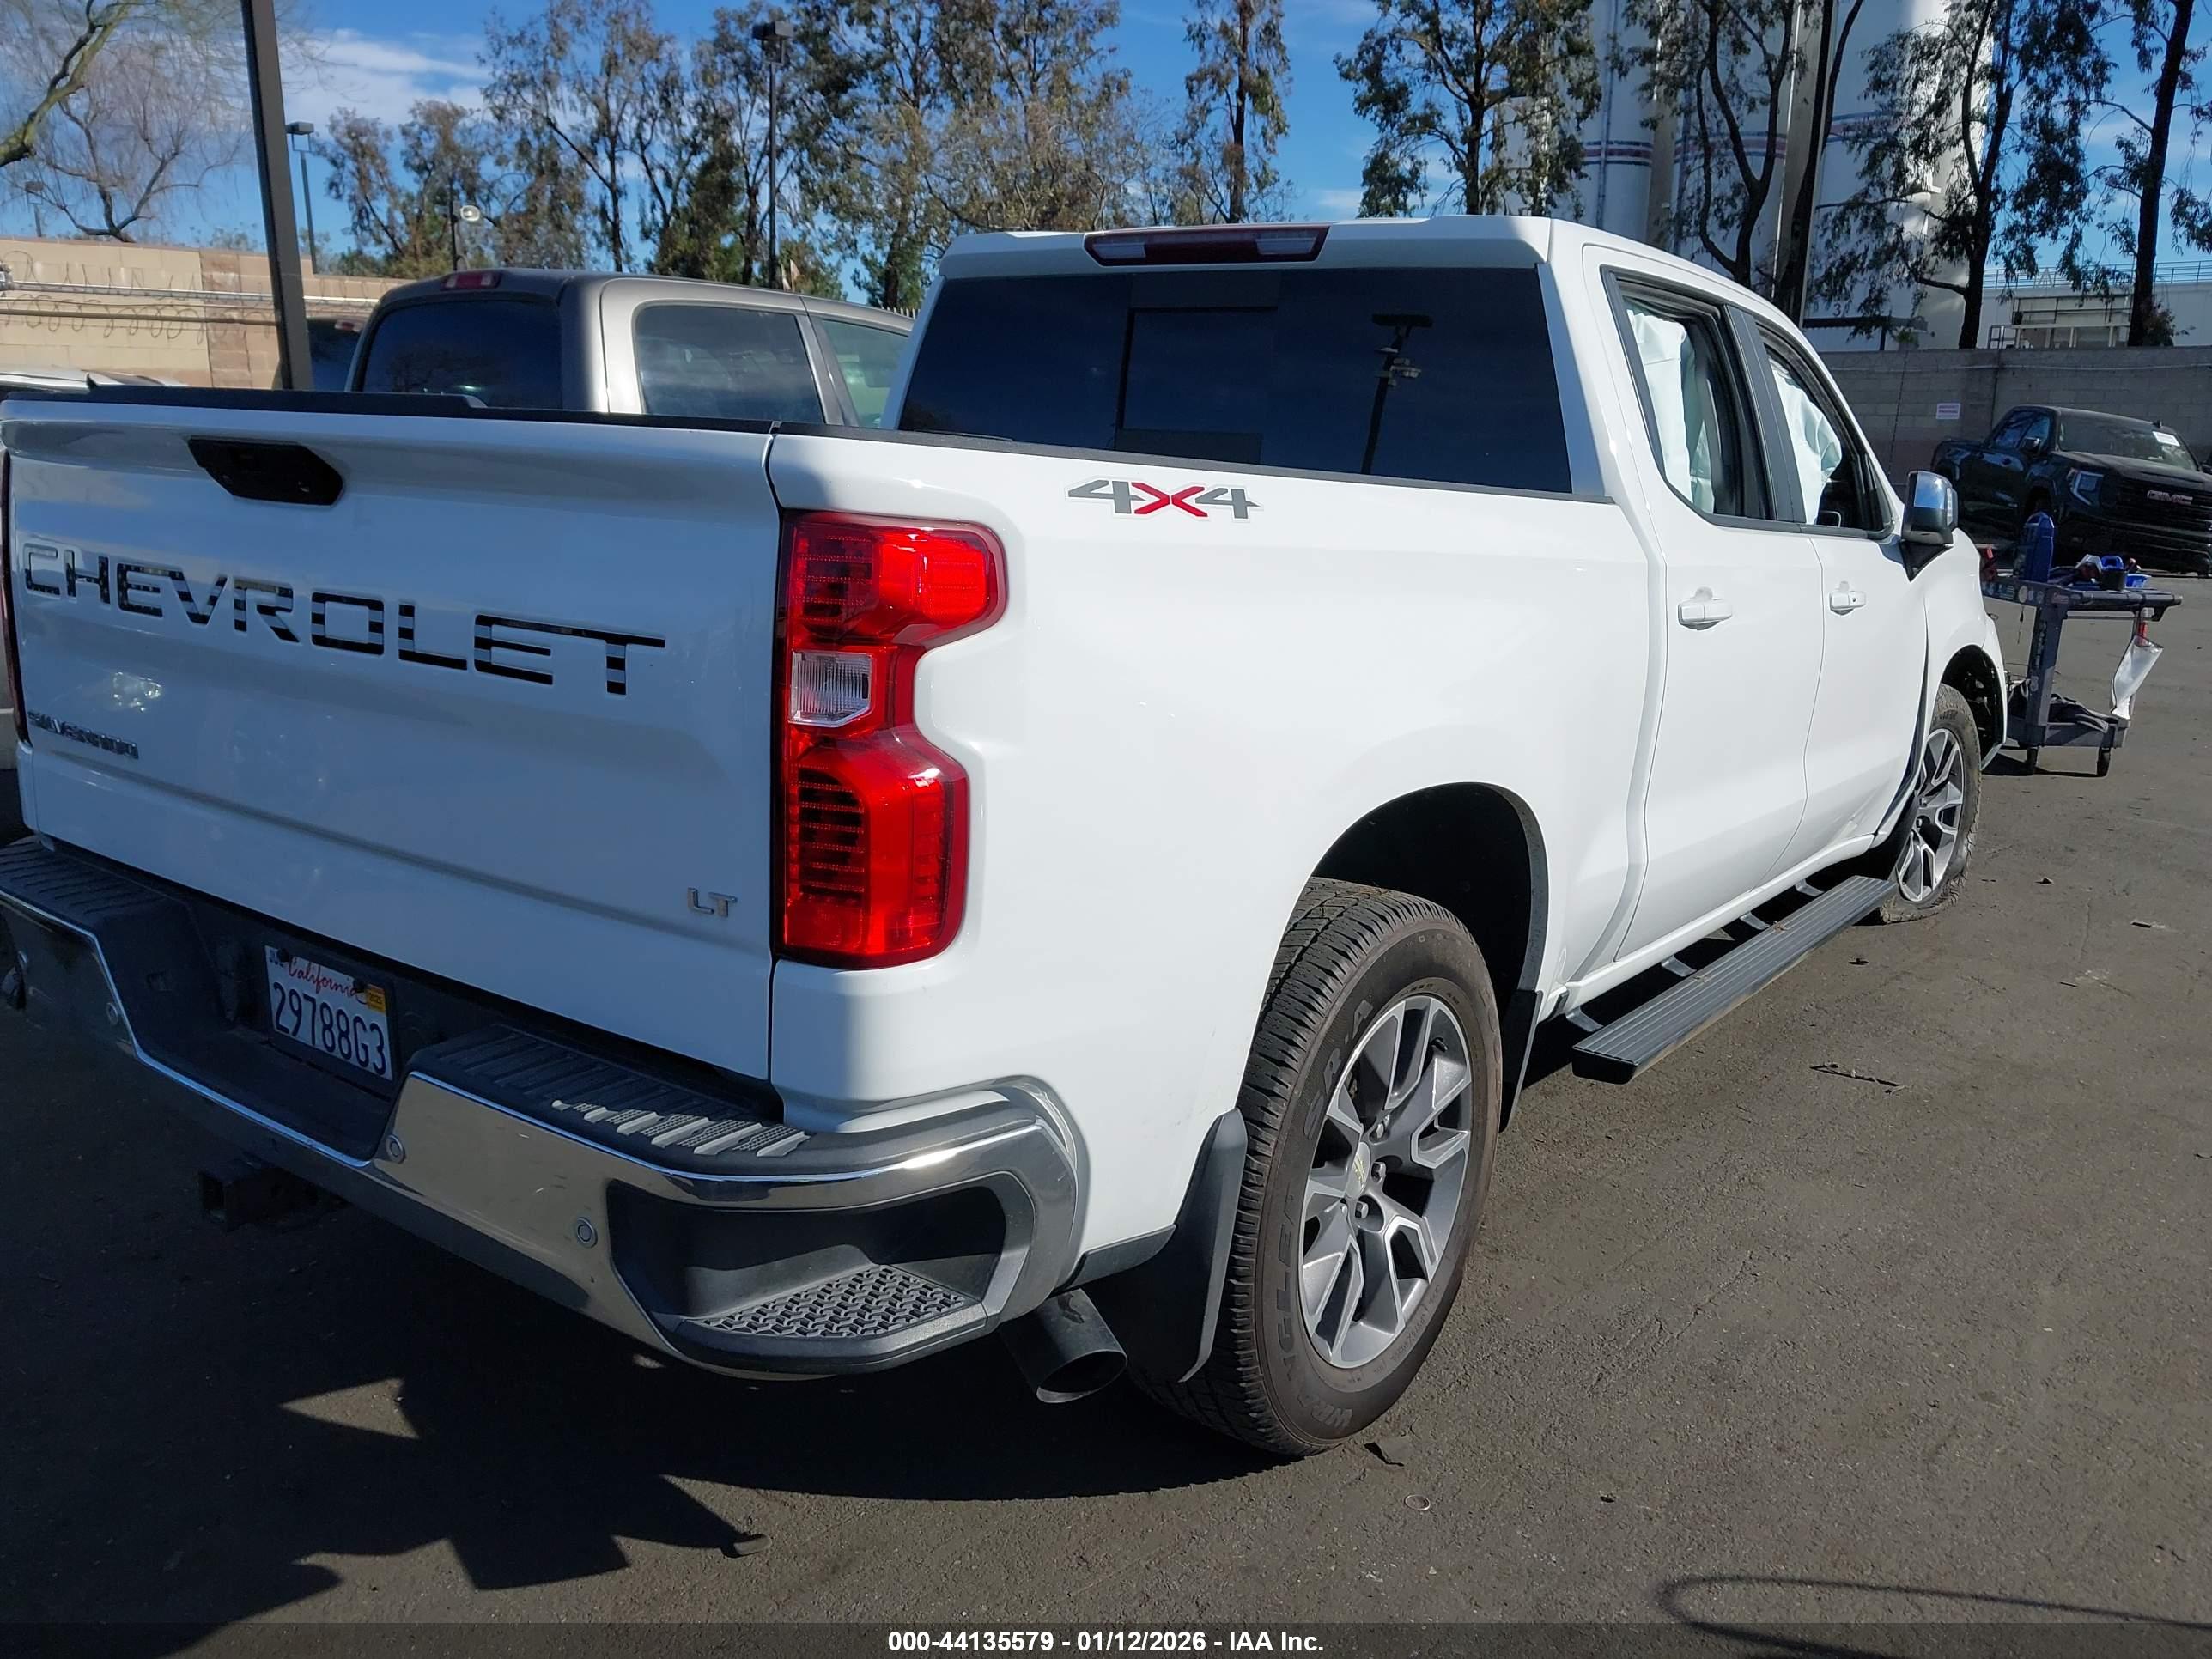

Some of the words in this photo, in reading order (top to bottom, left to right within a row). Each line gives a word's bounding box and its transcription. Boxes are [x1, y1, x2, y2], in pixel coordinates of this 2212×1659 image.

[23, 542, 665, 696] CHEVROLET
[687, 886, 738, 919] LT
[288, 955, 368, 1005] California
[273, 981, 386, 1076] 29788G3
